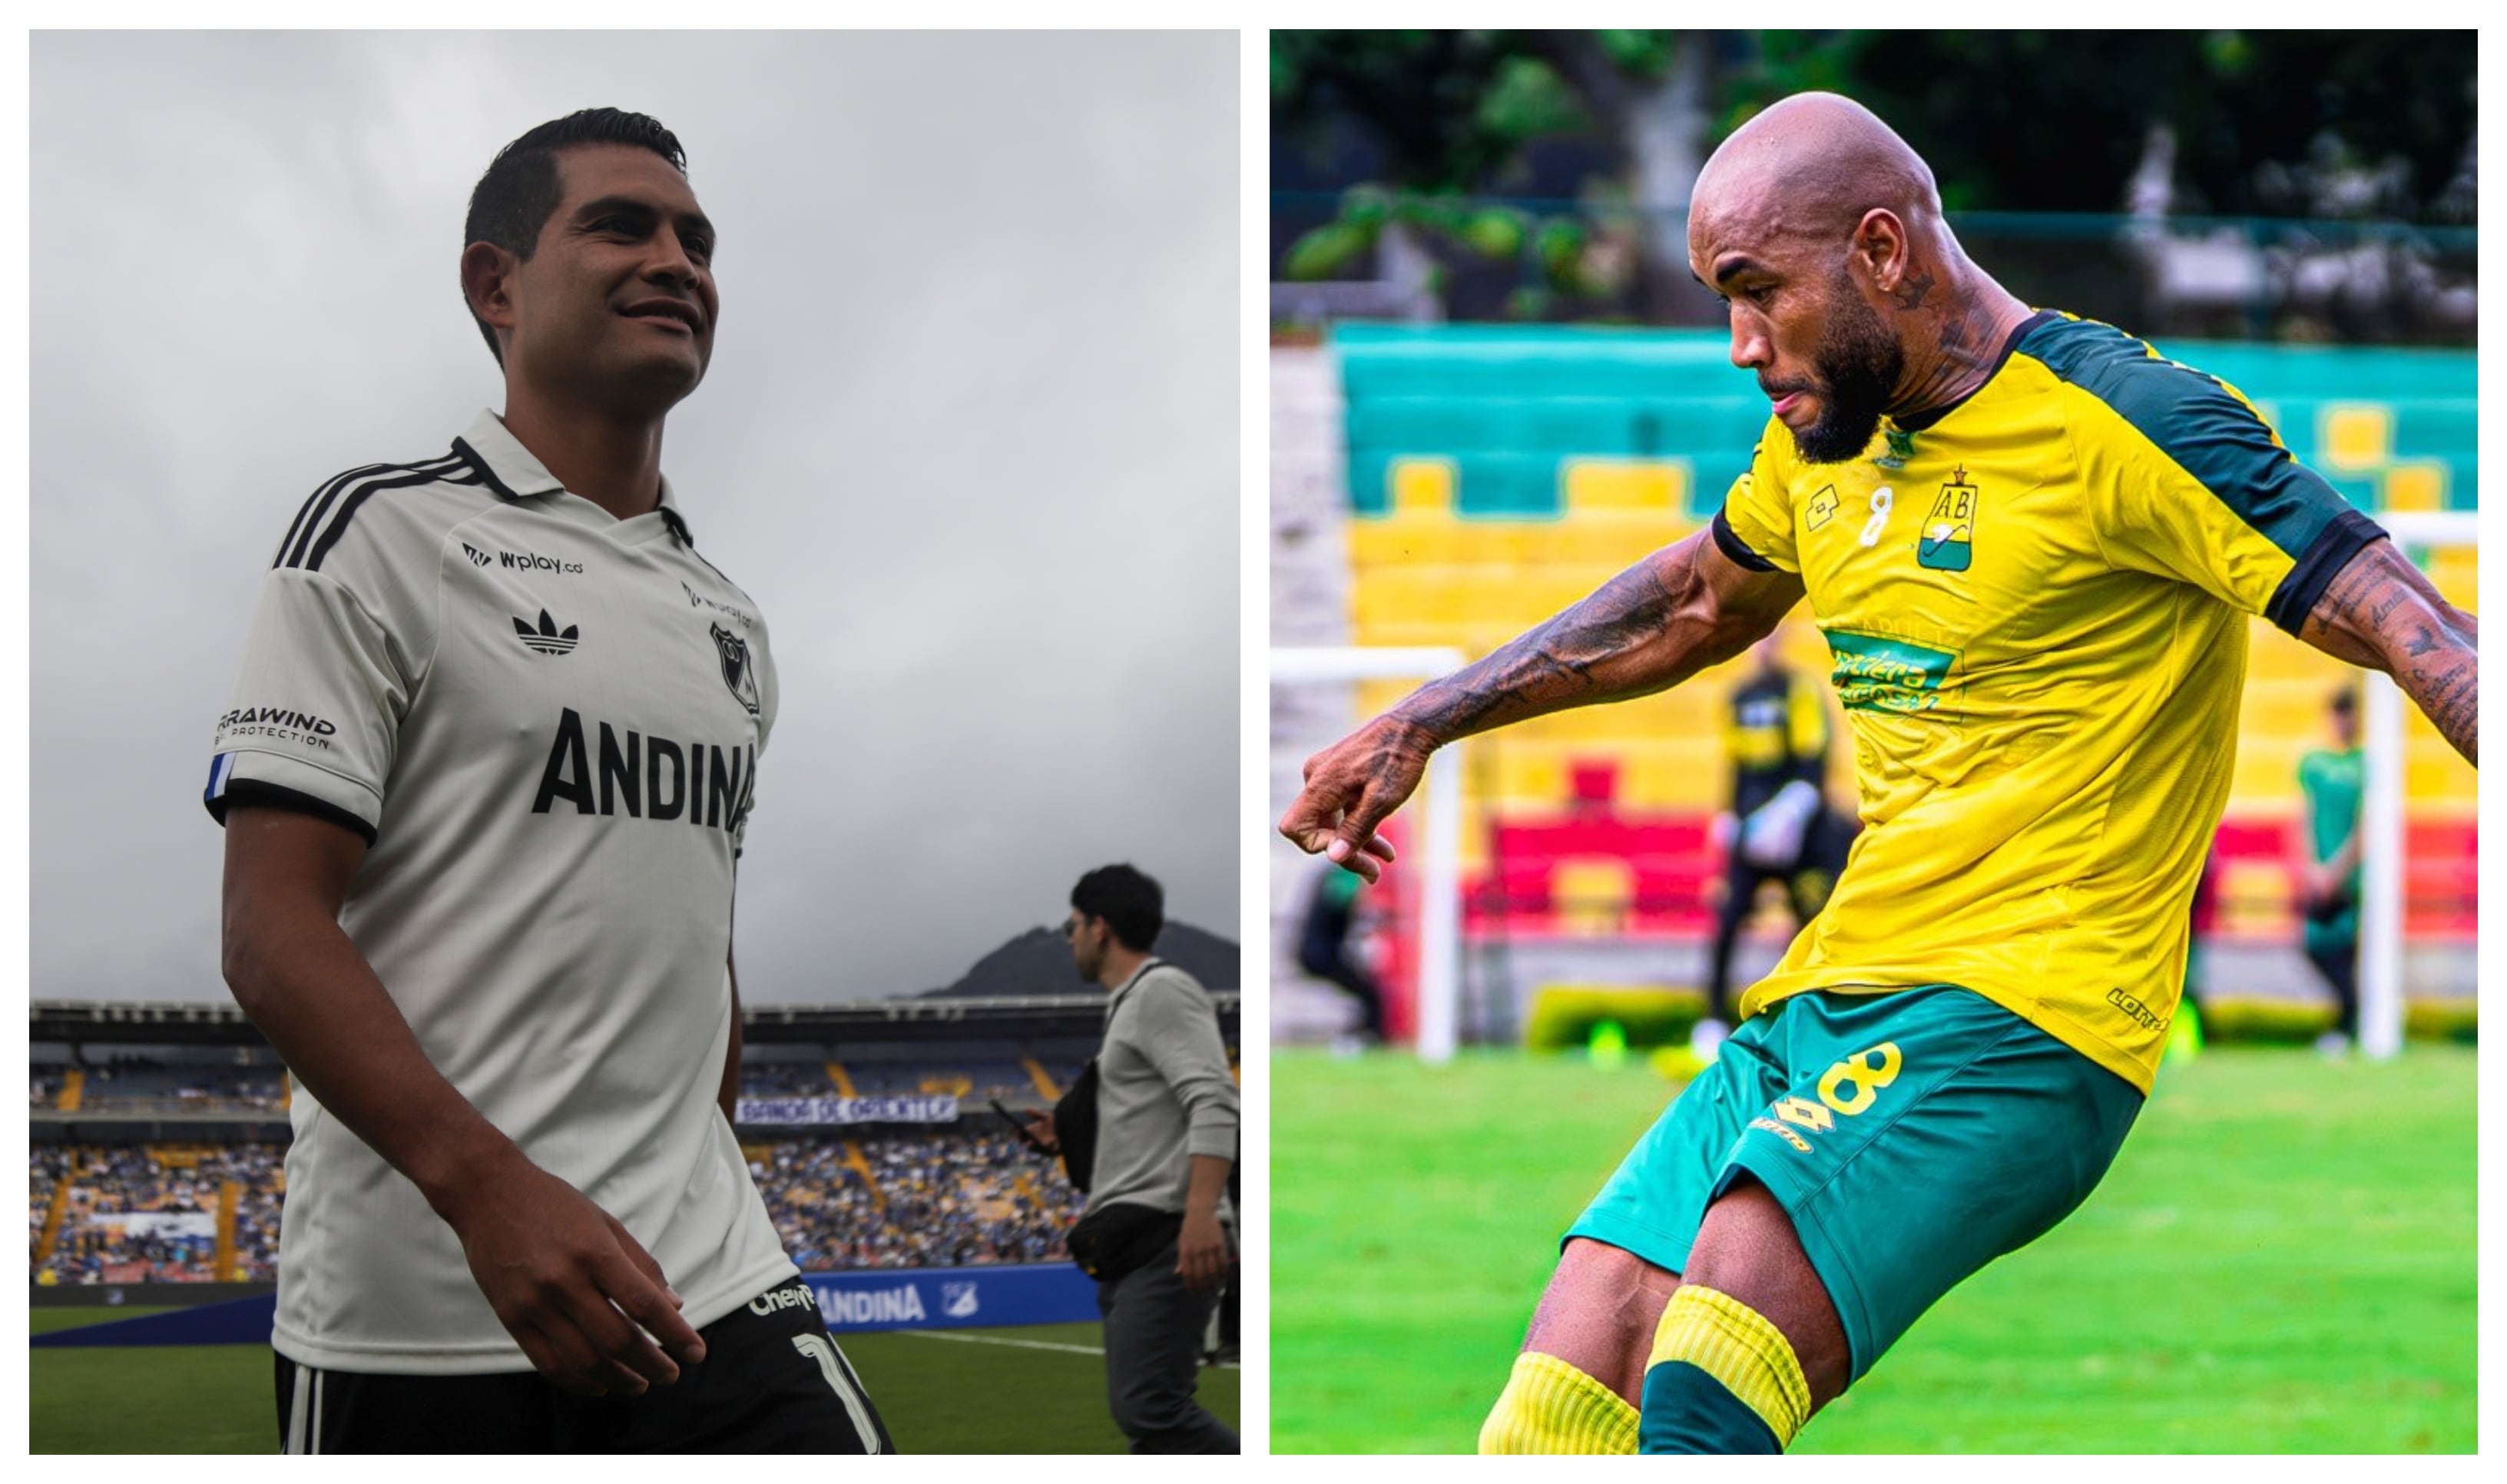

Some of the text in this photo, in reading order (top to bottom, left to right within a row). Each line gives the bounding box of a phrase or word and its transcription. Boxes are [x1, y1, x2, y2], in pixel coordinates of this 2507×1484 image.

[500, 551, 583, 575] Wplay.co
[231, 725, 330, 750] PROTECTION
[532, 707, 757, 836] ANDINA
[1817, 1042, 1903, 1116] 8
[816, 1284, 926, 1323] ANDINA
